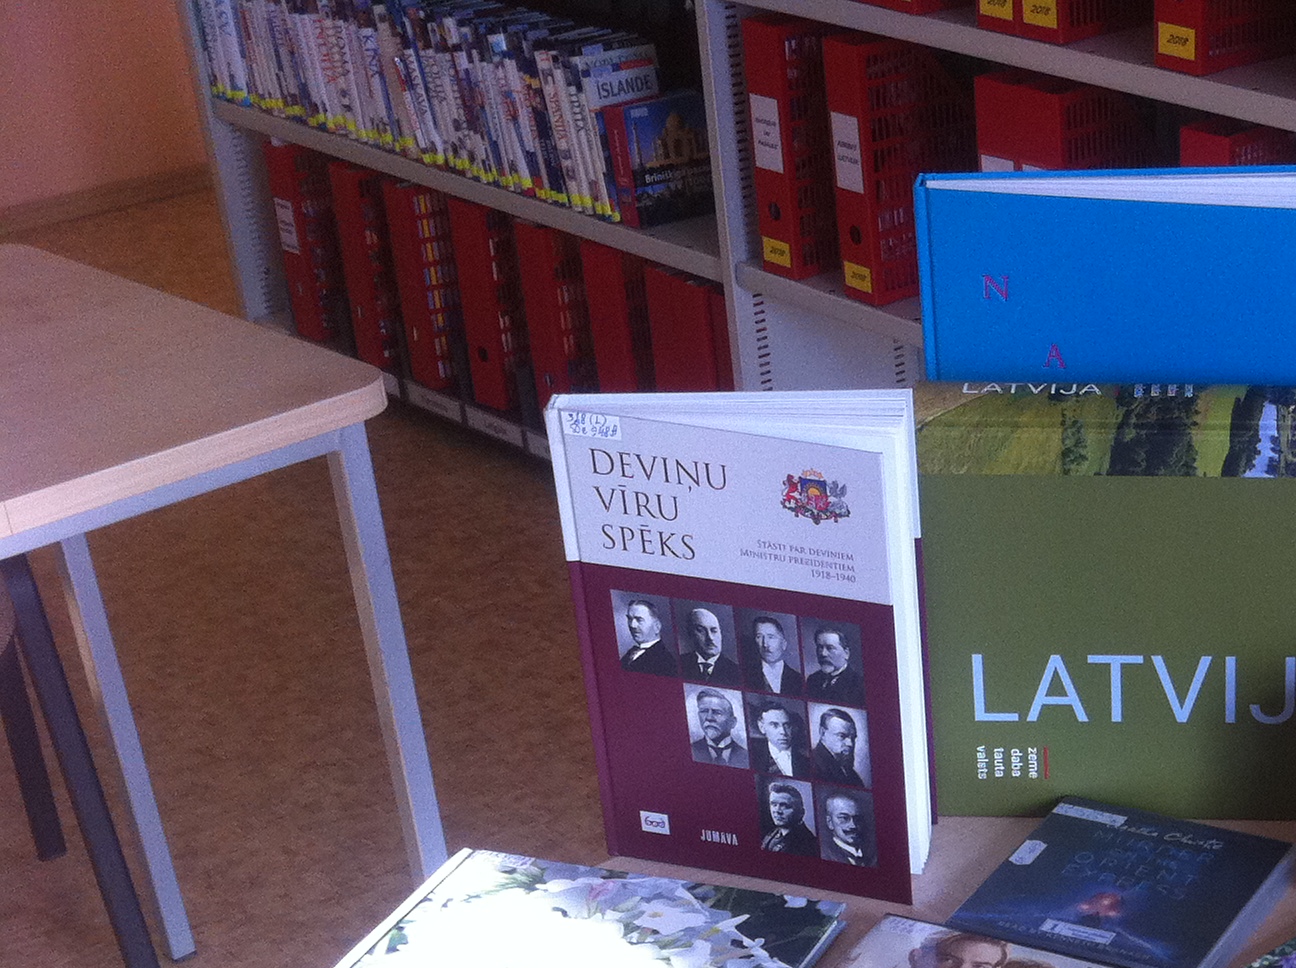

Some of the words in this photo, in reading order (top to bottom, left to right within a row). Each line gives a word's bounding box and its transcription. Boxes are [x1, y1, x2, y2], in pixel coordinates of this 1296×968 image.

[1030, 4, 1051, 16] 2018
[1167, 33, 1189, 47] 2018
[983, 275, 1009, 301] N
[1043, 344, 1066, 369] A
[962, 383, 1102, 395] LATVIJA
[589, 448, 727, 493] DEVIŅU
[593, 485, 679, 521] VĪRU
[601, 524, 696, 561] SPĒKS
[976, 745, 989, 780] valsts
[994, 747, 1005, 778] tauta
[1010, 748, 1023, 777] daba
[1028, 747, 1039, 779] zeme
[700, 829, 738, 846] JUMAVA
